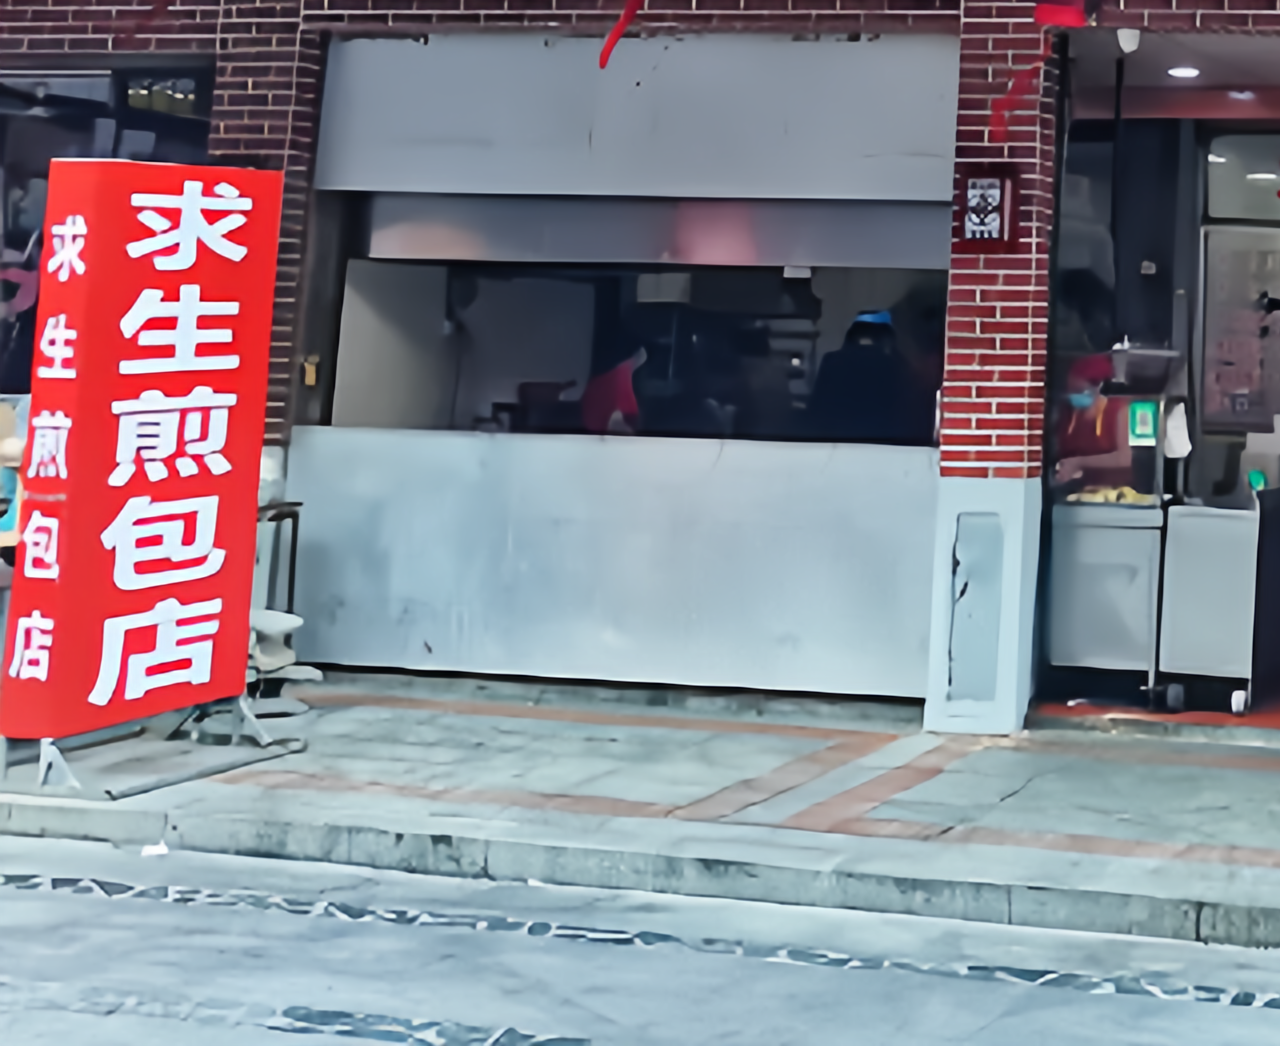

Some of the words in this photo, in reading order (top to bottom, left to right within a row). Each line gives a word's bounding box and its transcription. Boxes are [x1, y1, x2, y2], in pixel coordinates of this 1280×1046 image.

[8, 214, 88, 682] 求生煎包店
[89, 179, 254, 707] 求生煎包店
